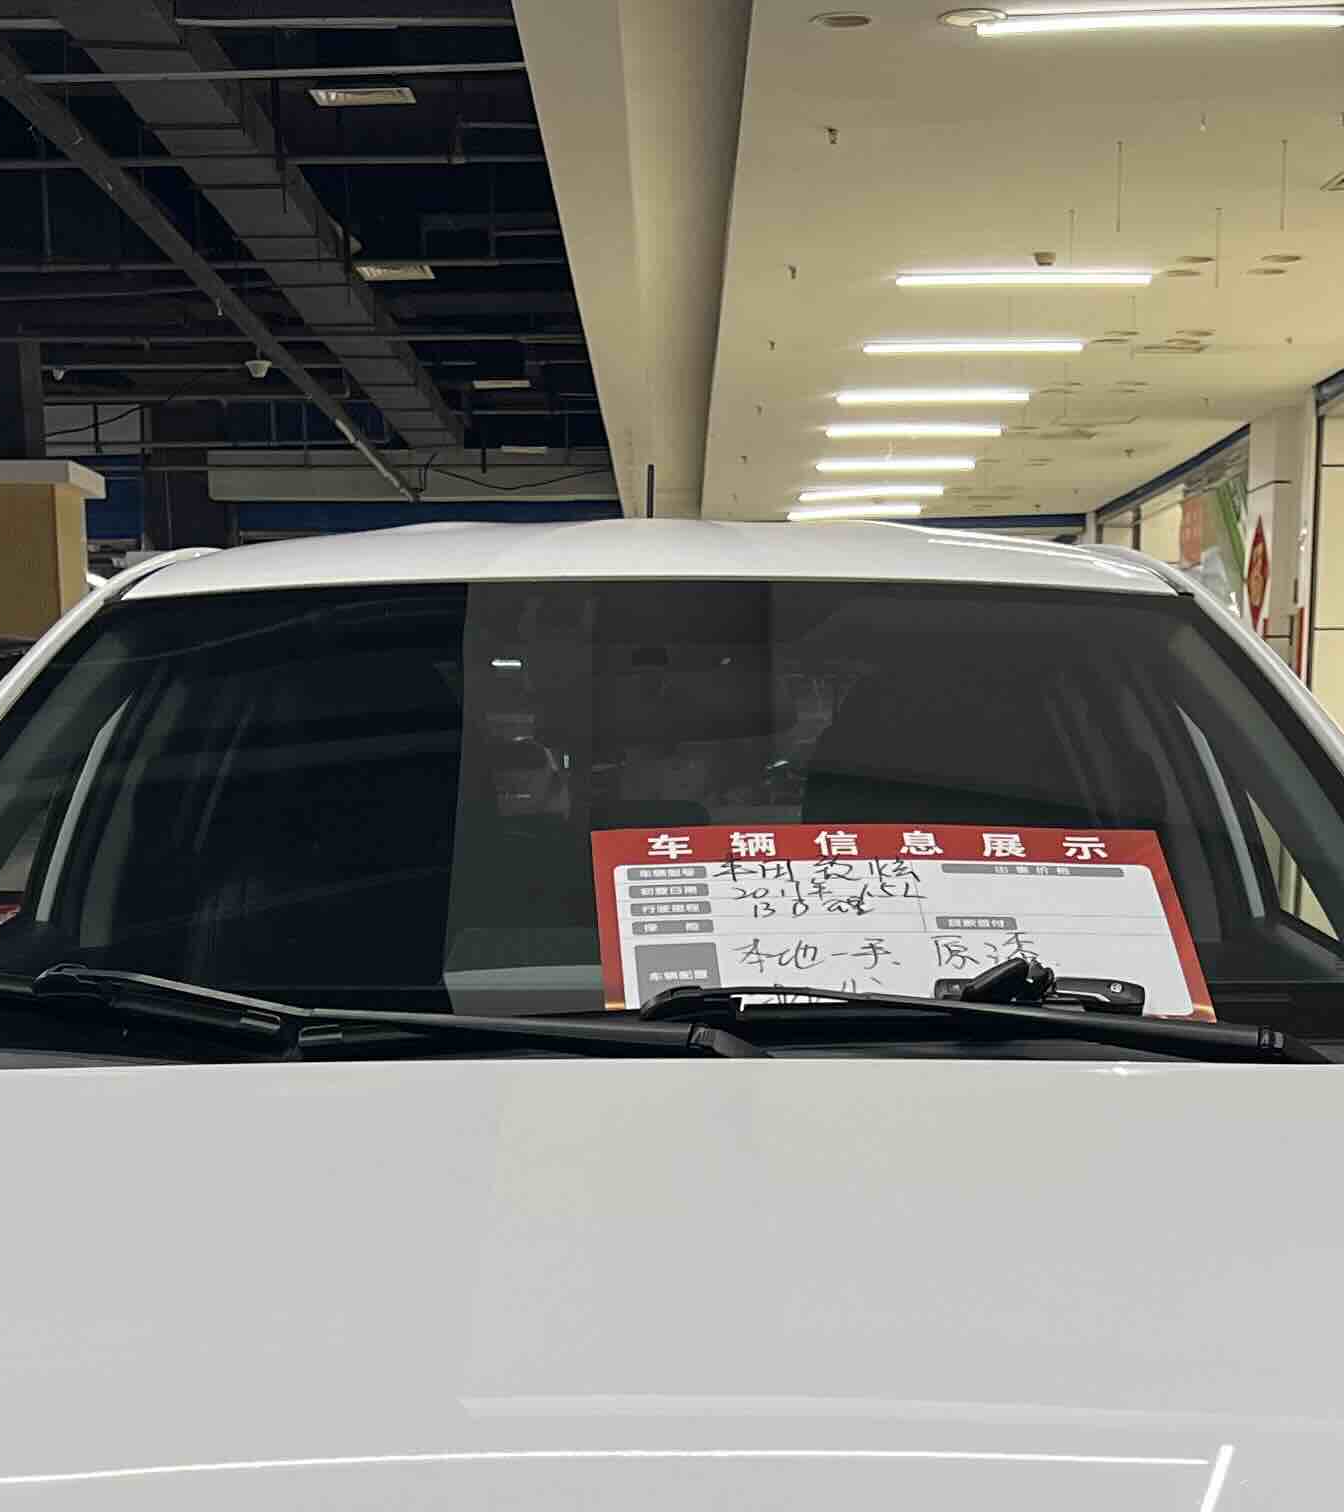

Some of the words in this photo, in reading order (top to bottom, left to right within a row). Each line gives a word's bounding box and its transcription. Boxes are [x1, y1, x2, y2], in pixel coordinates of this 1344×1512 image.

[647, 831, 1109, 859] 车辆信息展示
